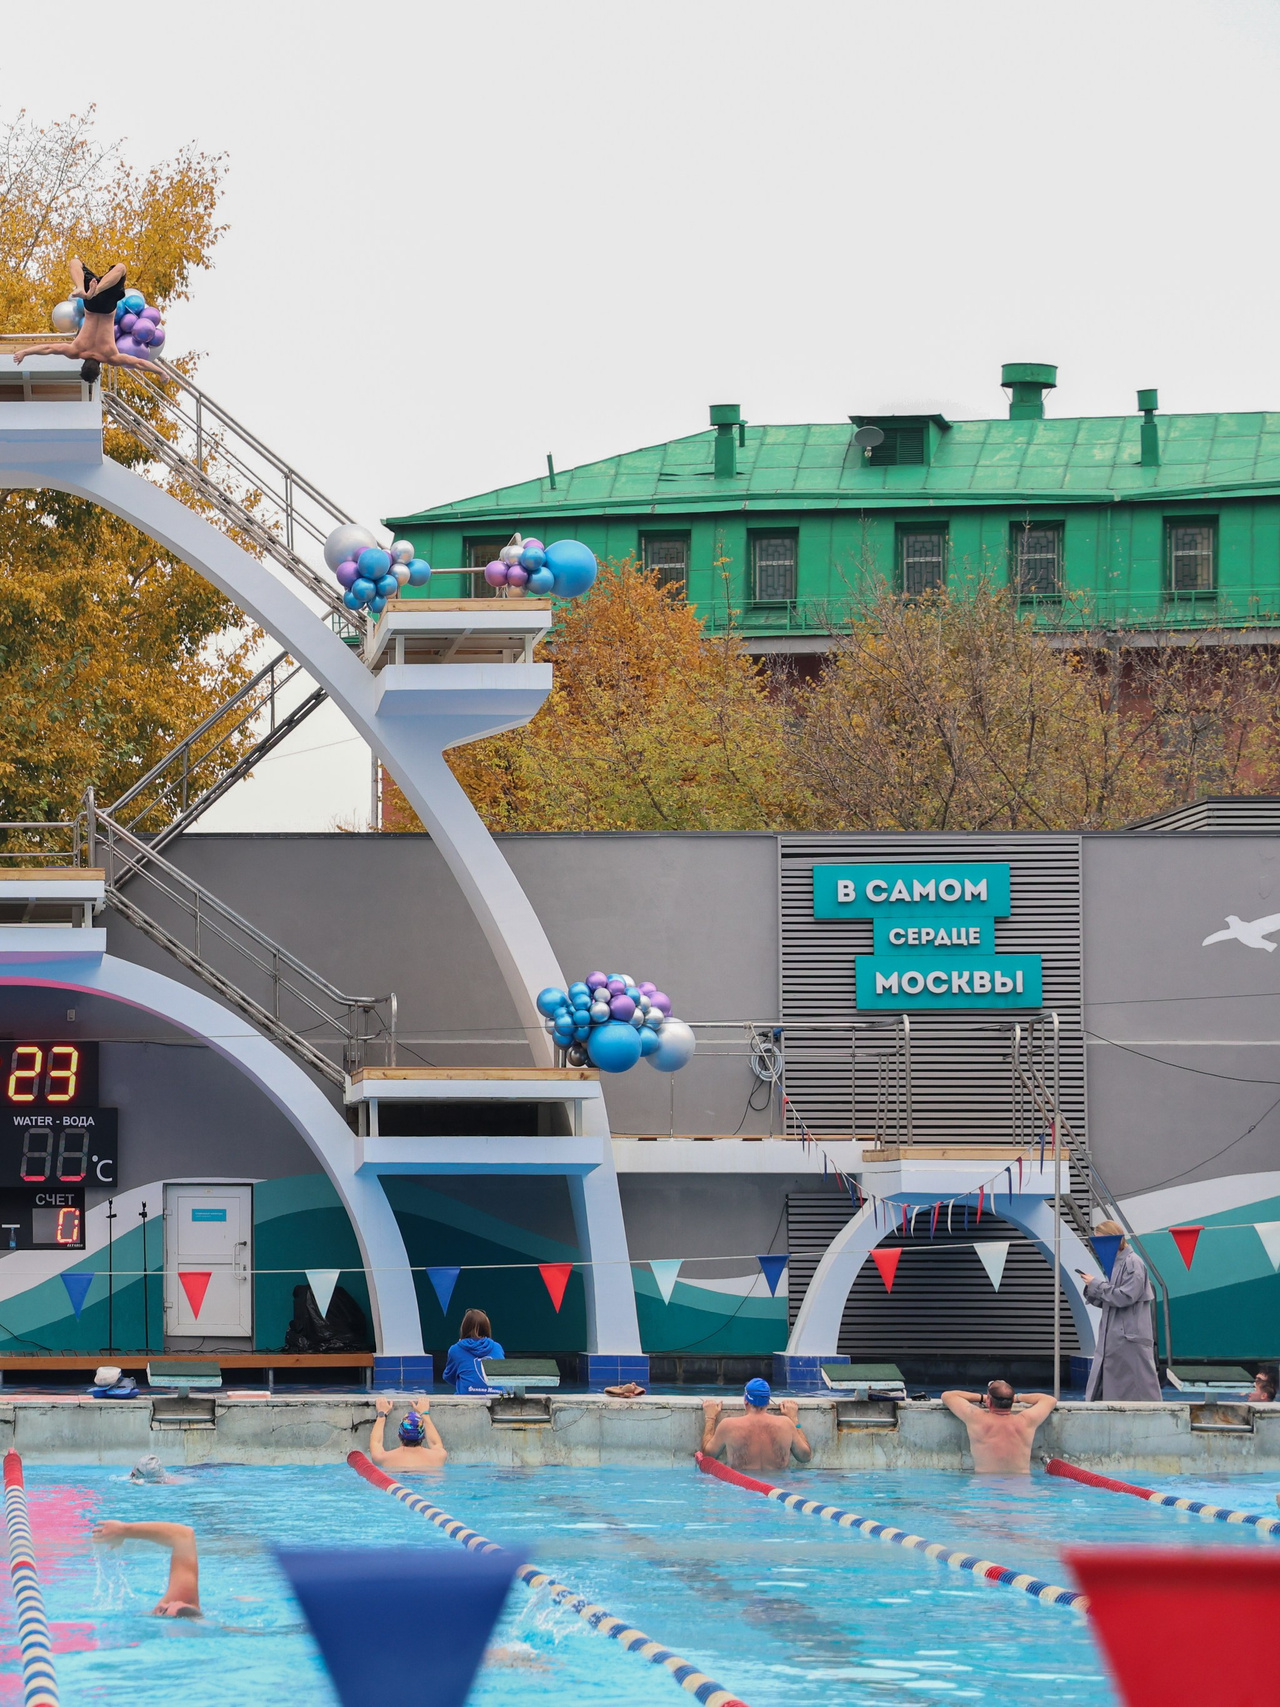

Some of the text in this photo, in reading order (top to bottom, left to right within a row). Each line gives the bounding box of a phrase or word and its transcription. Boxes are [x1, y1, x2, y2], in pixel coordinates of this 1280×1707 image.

[837, 878, 988, 903] В САМОМ
[888, 927, 981, 946] СЕРДЦЕ
[875, 970, 1024, 995] МОСКВЫ
[13, 1116, 53, 1126] WATER
[63, 1116, 95, 1127] ВОДА
[35, 1193, 75, 1206] СЧЕТ
